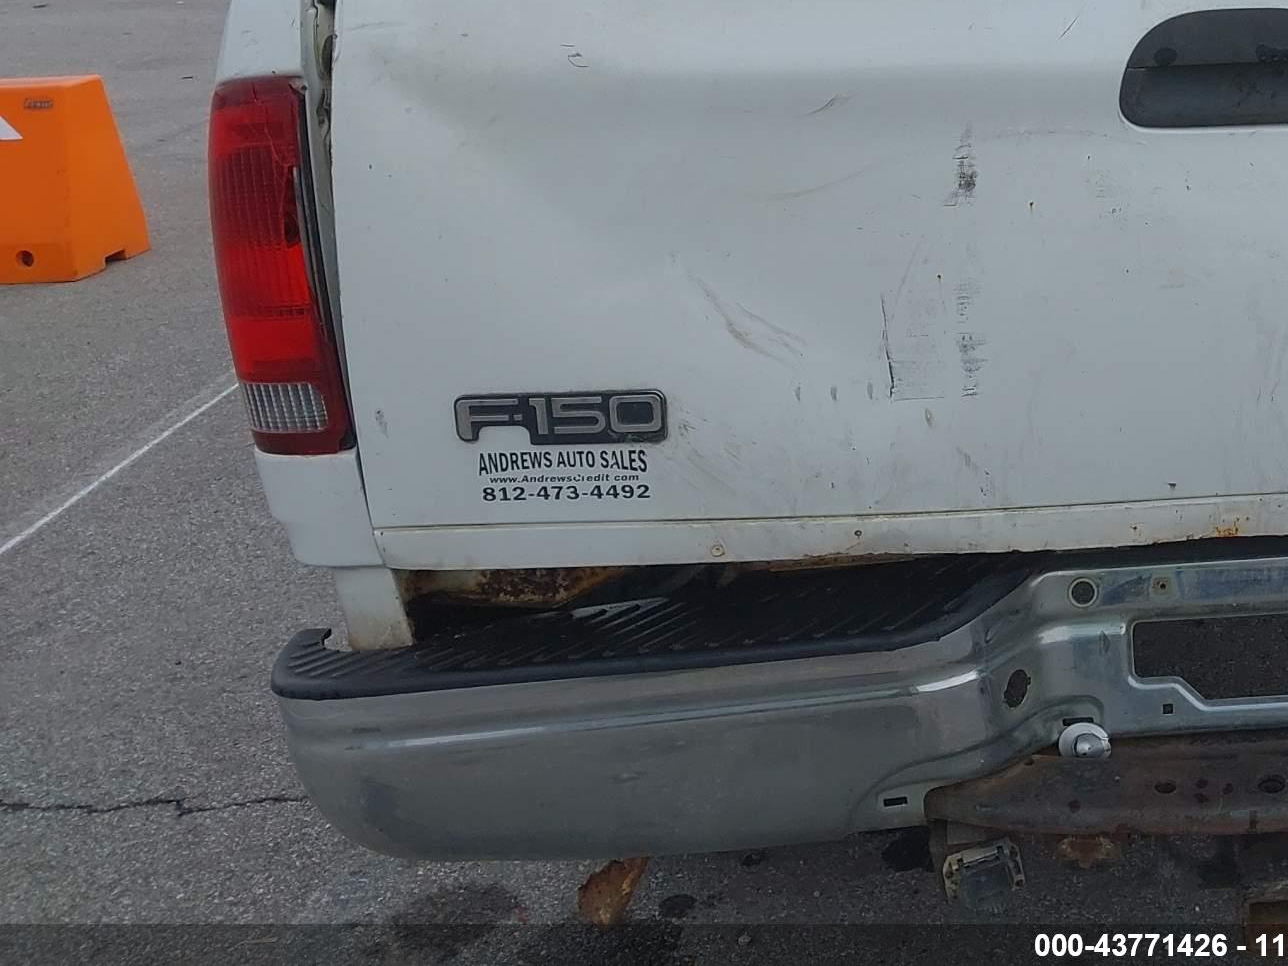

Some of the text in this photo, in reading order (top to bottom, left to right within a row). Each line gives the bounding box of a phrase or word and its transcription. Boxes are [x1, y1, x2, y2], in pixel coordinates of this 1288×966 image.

[454, 393, 665, 443] F-150
[478, 449, 648, 476] ANDREWS AUTO SALES
[482, 484, 650, 502] 812-473-4492
